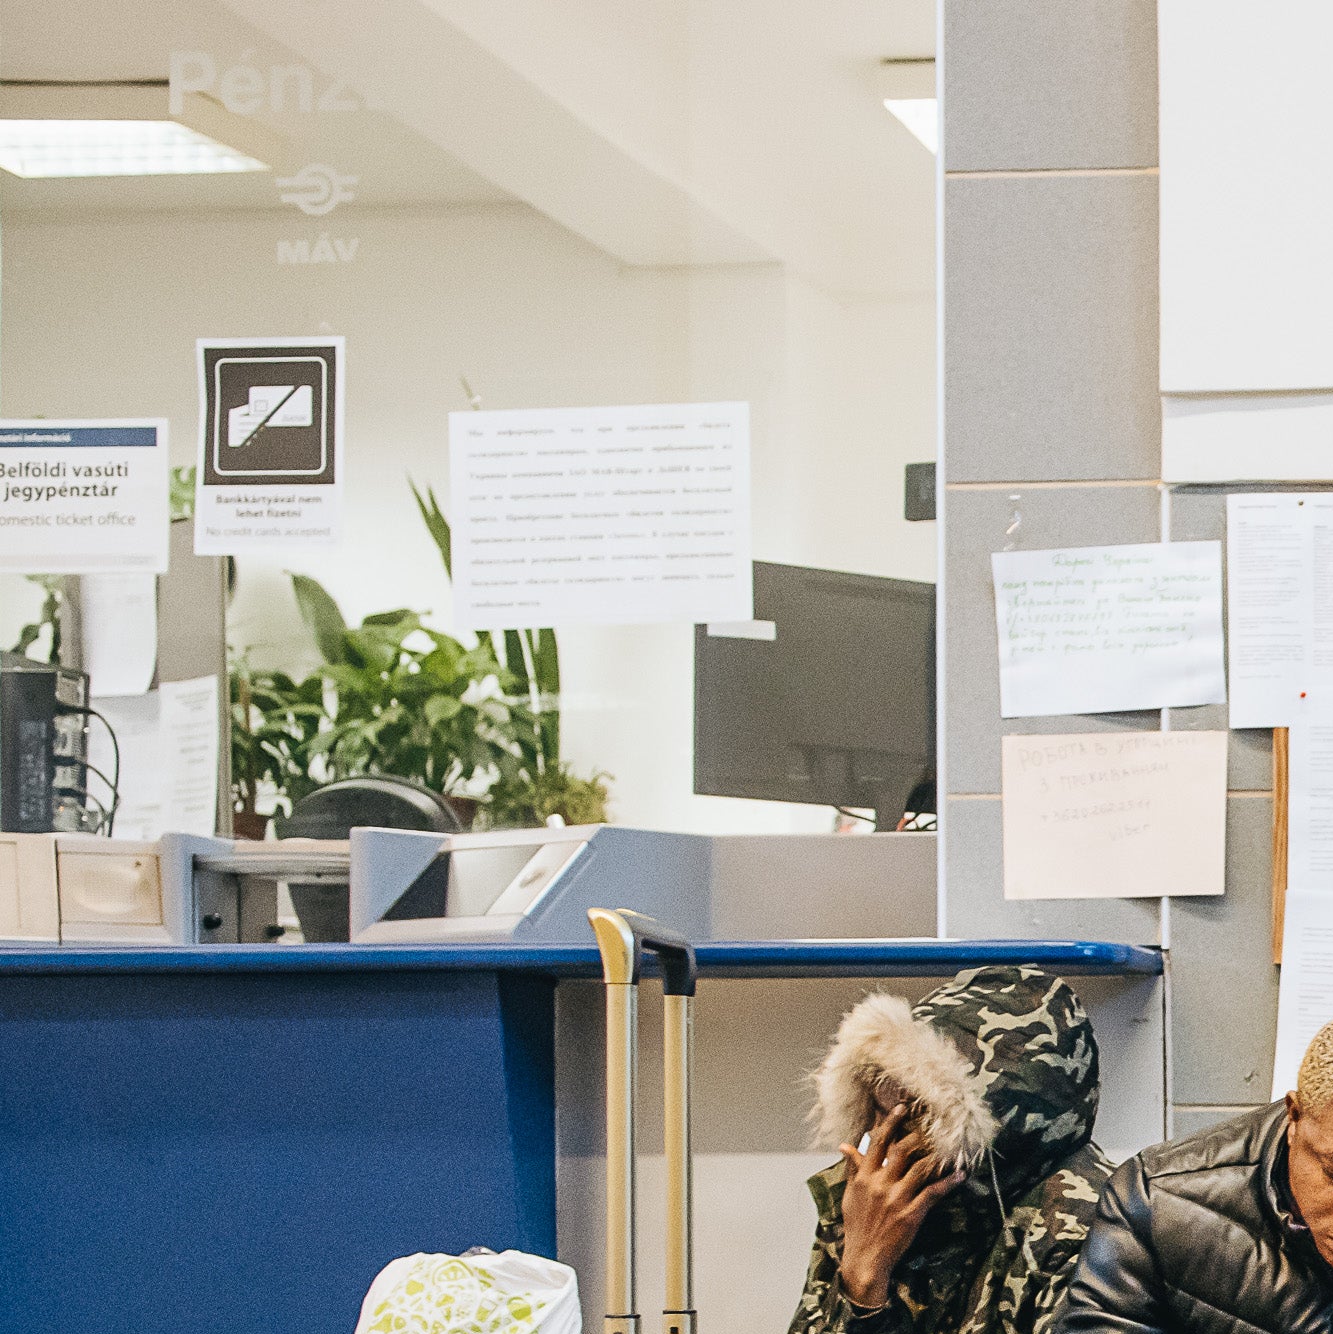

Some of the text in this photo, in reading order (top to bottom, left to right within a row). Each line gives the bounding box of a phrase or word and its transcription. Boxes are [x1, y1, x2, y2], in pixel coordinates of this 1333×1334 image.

[276, 232, 360, 264] MÁV
[73, 461, 129, 478] vasúti
[4, 482, 118, 502] jegypénztár
[0, 511, 136, 526] omestic ticket office
